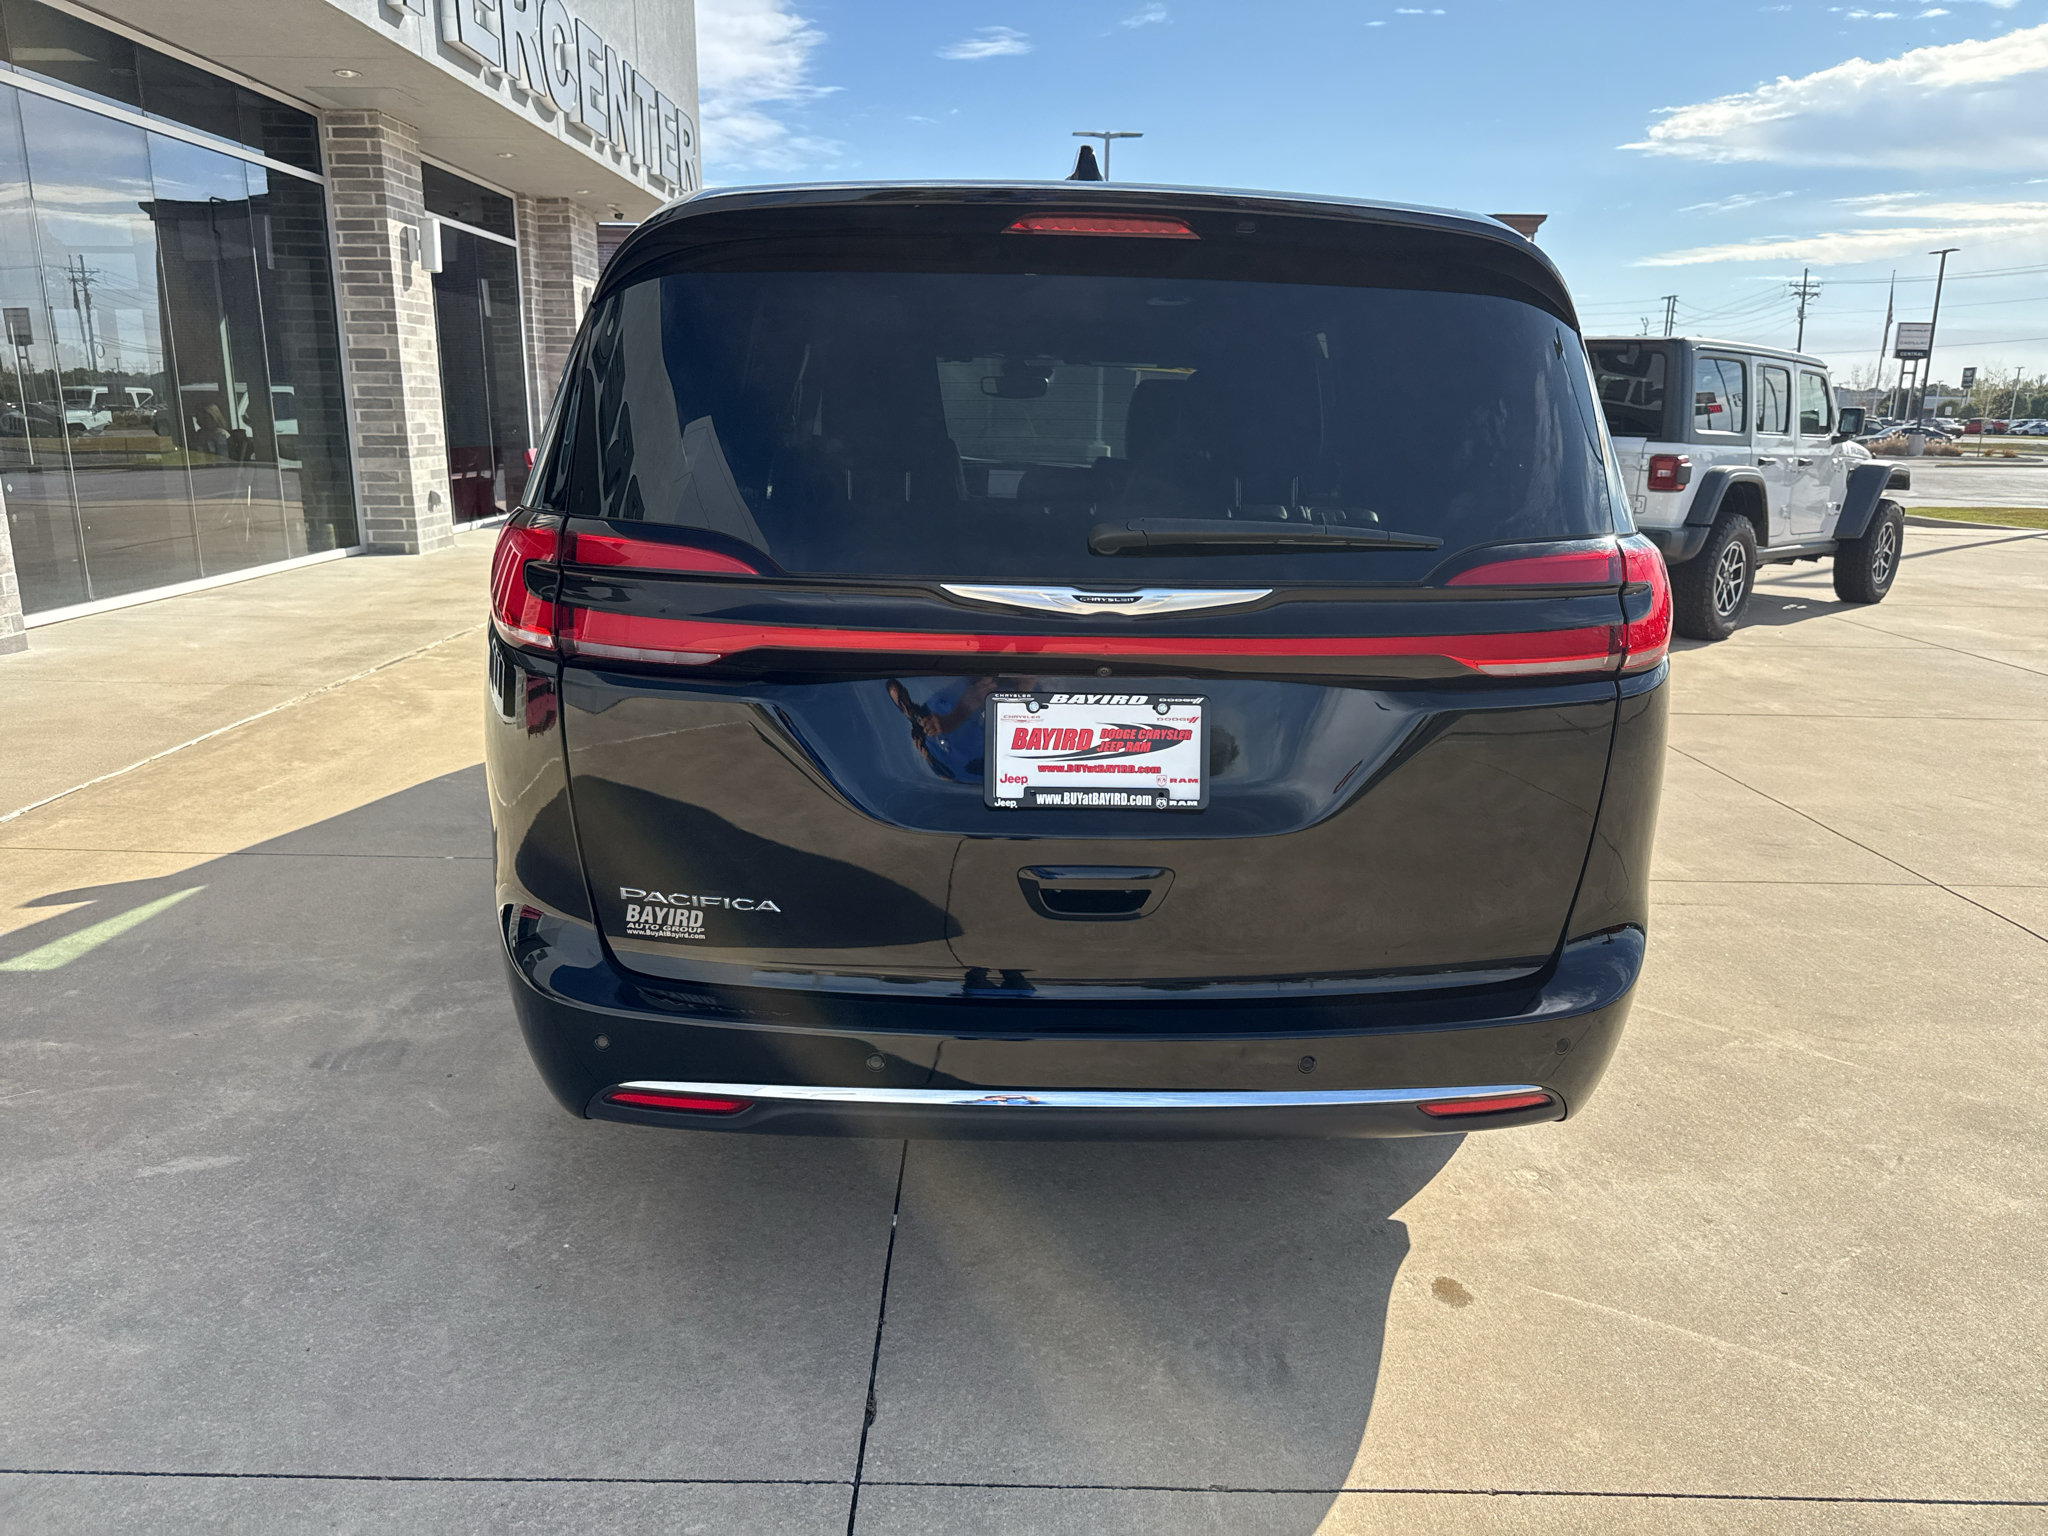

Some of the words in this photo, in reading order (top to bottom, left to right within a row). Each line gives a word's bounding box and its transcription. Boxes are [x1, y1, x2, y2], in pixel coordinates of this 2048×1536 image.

[1049, 694, 1149, 705] BAYIRD
[1011, 727, 1094, 751] BAYIRD
[1100, 728, 1137, 740] DODGE
[1138, 729, 1193, 741] CHRYSLER
[1096, 741, 1123, 753] JEEP
[1124, 741, 1152, 753] RAM
[1037, 764, 1162, 775] www.BUYatBAYIRD.com
[999, 773, 1029, 785] Jeep
[994, 798, 1018, 809] Jeep
[1035, 791, 1152, 807] www.BUYatBAYIRD.com
[619, 886, 782, 913] PACIFICA
[625, 904, 704, 928] BAYIRD
[627, 922, 660, 931] AUTO
[664, 925, 705, 933] GROUP
[626, 928, 706, 940] www.BuyAtBayird.com
